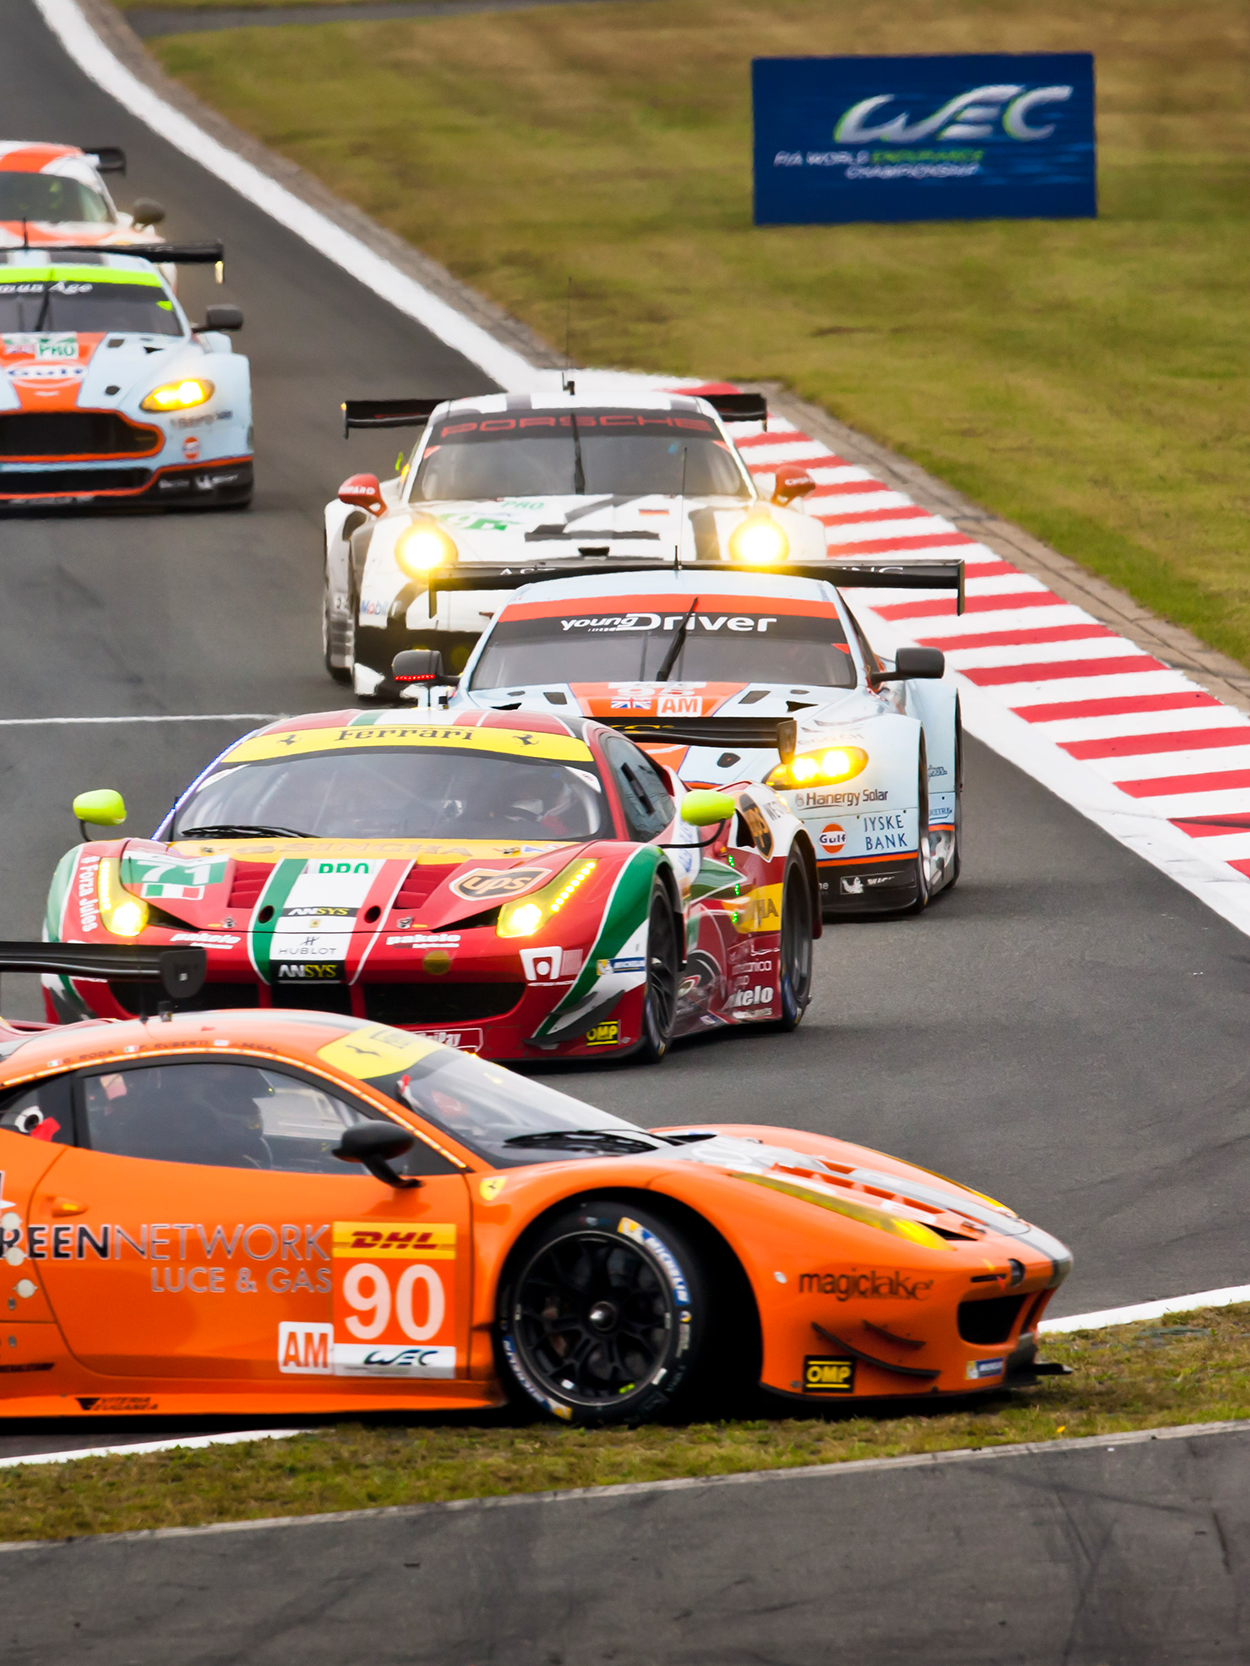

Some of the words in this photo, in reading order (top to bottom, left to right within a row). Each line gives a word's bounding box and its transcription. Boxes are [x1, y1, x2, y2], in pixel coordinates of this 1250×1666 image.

[833, 84, 1073, 143] WEC
[440, 415, 714, 438] PORSCHE
[661, 698, 698, 714] AM
[334, 728, 473, 742] Ferrari
[806, 792, 861, 807] Hanergy
[862, 789, 889, 802] Solar
[863, 815, 905, 833] JYSKE
[818, 834, 847, 844] Gulf
[865, 833, 908, 851] BANK
[283, 842, 474, 857] SINGHA
[78, 863, 99, 898] Forza
[135, 859, 212, 886] 71
[461, 876, 534, 895] ups
[78, 899, 101, 933] Jules
[287, 907, 350, 916] ANSYS
[277, 947, 337, 956] HUBLOT
[277, 964, 339, 979] ANSYS
[585, 1024, 619, 1042] OMP
[350, 1230, 438, 1250] DHL
[151, 1267, 225, 1293] LUCE
[235, 1267, 258, 1293] &
[266, 1266, 333, 1294] GAS
[342, 1262, 446, 1342] 90
[282, 1331, 330, 1369] AM
[362, 1348, 440, 1367] WEC
[806, 1364, 851, 1383] OMP
